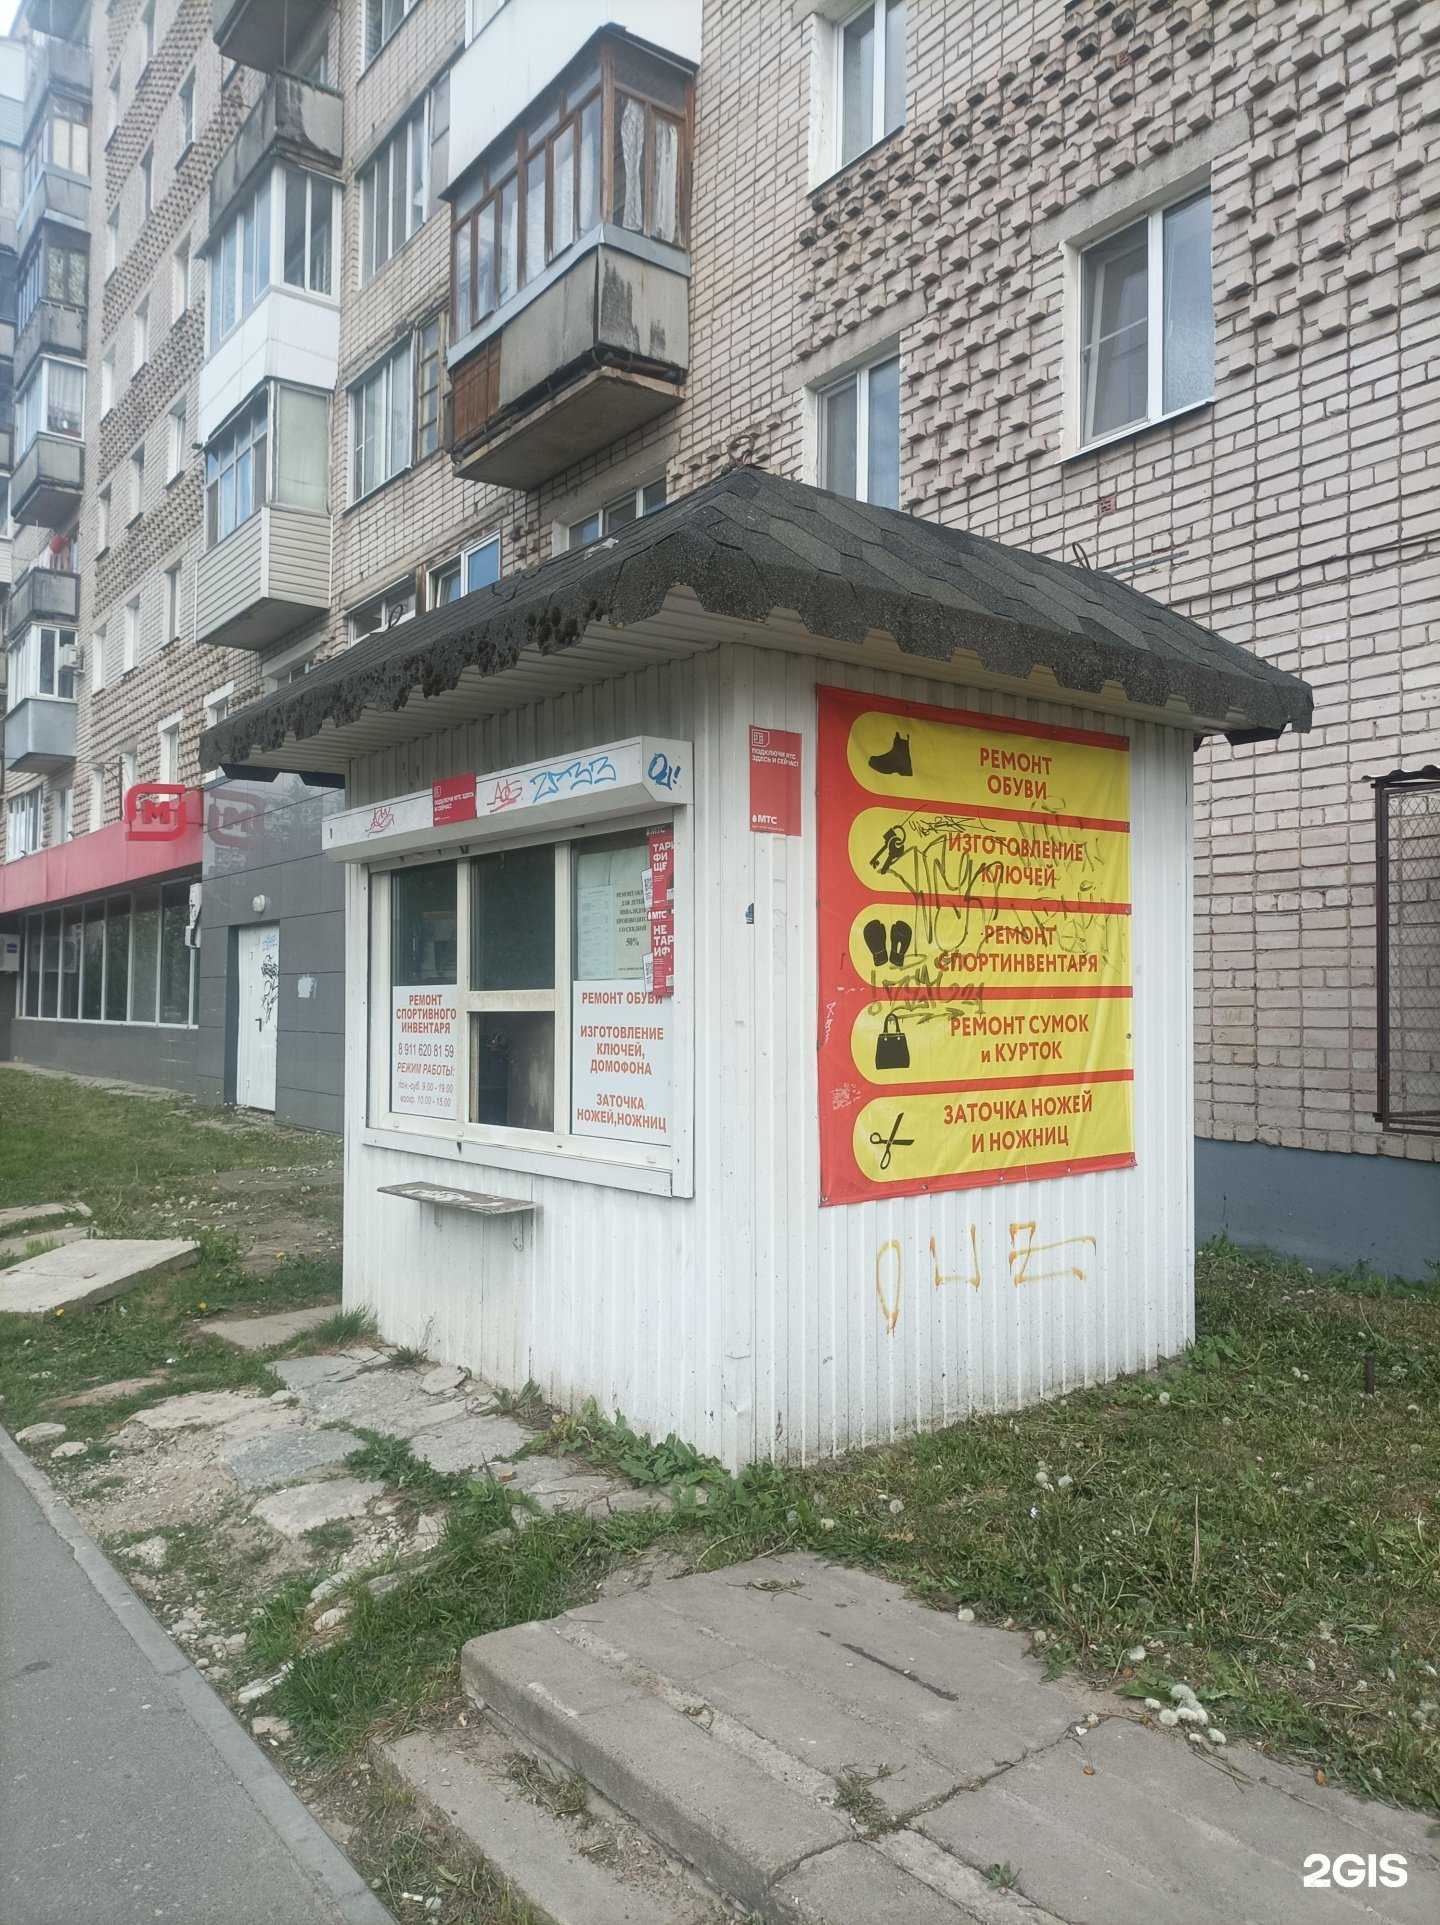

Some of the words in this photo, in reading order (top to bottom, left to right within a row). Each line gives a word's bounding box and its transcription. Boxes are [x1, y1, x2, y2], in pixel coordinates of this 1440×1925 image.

[979, 747, 1052, 775] РЕМОНТ
[987, 774, 1047, 800] ОБУВИ
[758, 815, 777, 825] МТС
[948, 832, 1083, 862] ИЗГОТОВЛЕНИЕ
[653, 852, 668, 862] ФИ
[980, 862, 1056, 887] КЛЮЧЕЙ
[653, 910, 667, 919] МТС
[653, 925, 668, 935] НЕ
[984, 925, 1057, 945] РЕМОНТ
[653, 946, 671, 957] ИФ
[938, 953, 1098, 973] СПОРТИНВЕНТАРЯ
[409, 994, 443, 1006] РЕМОНТ
[582, 992, 623, 1005] РЕМОНТ
[396, 1008, 457, 1020] СПОРТИВНОГО
[401, 1022, 451, 1034] ИНВЕНТАРЯ
[580, 1025, 664, 1041] ИЗГОТОВЛЕНИЕ
[950, 1015, 1025, 1037] РЕМОНТ
[1029, 1013, 1089, 1034] СУМОК
[398, 1042, 403, 1056] 8
[404, 1043, 416, 1056] 911
[418, 1043, 431, 1057] 620
[433, 1044, 442, 1057] 81
[444, 1044, 455, 1058] 59
[596, 1041, 645, 1060] КЛЮЧЕЙ,
[995, 1041, 1063, 1063] КУРТОК
[397, 1062, 422, 1075] РЕЖИМ
[422, 1063, 456, 1078] РАБОТЫ:
[590, 1059, 652, 1076] ДОМОФОНА
[596, 1093, 645, 1110] ЗАТОЧКА
[942, 1098, 1028, 1125] ЗАТОЧКА
[1030, 1090, 1093, 1116] НОЖЕЙ
[971, 1133, 985, 1154] И
[989, 1125, 1069, 1153] НОЖНИЦ
